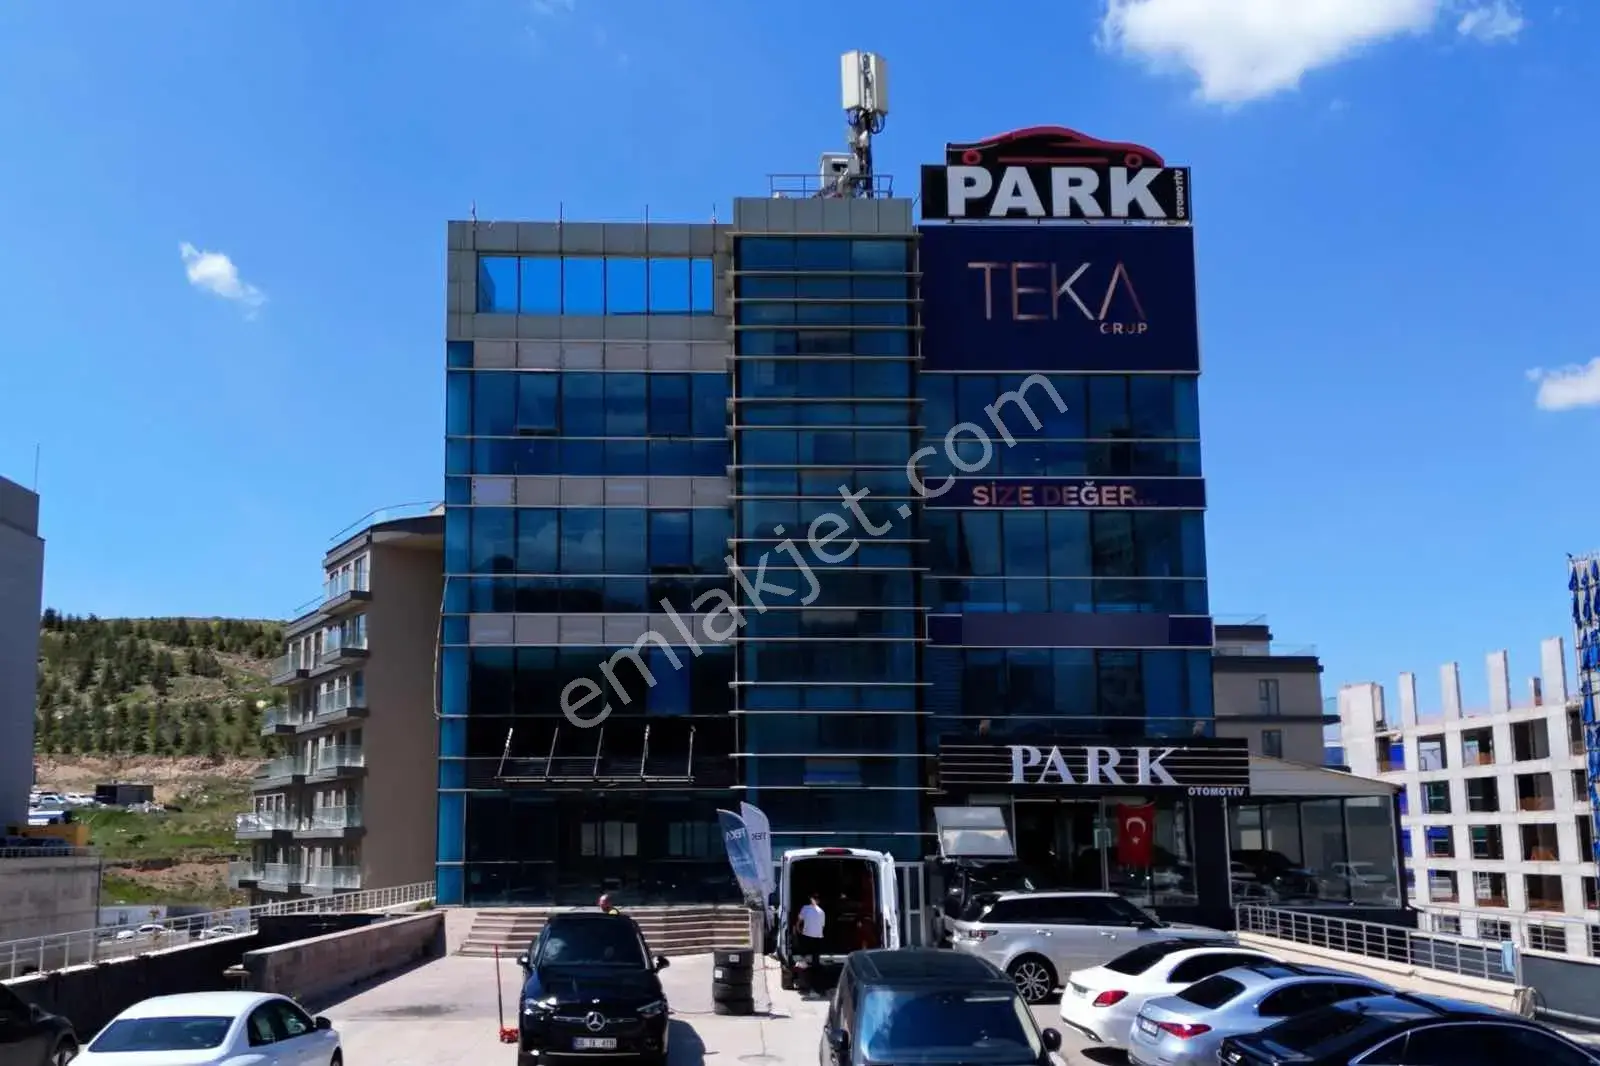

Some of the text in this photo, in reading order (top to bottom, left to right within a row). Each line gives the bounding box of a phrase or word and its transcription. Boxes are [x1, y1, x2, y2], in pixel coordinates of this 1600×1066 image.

[946, 165, 1167, 218] PARK
[967, 261, 1148, 321] TEKA
[972, 481, 1034, 506] SİZE
[1006, 745, 1185, 786] PARK
